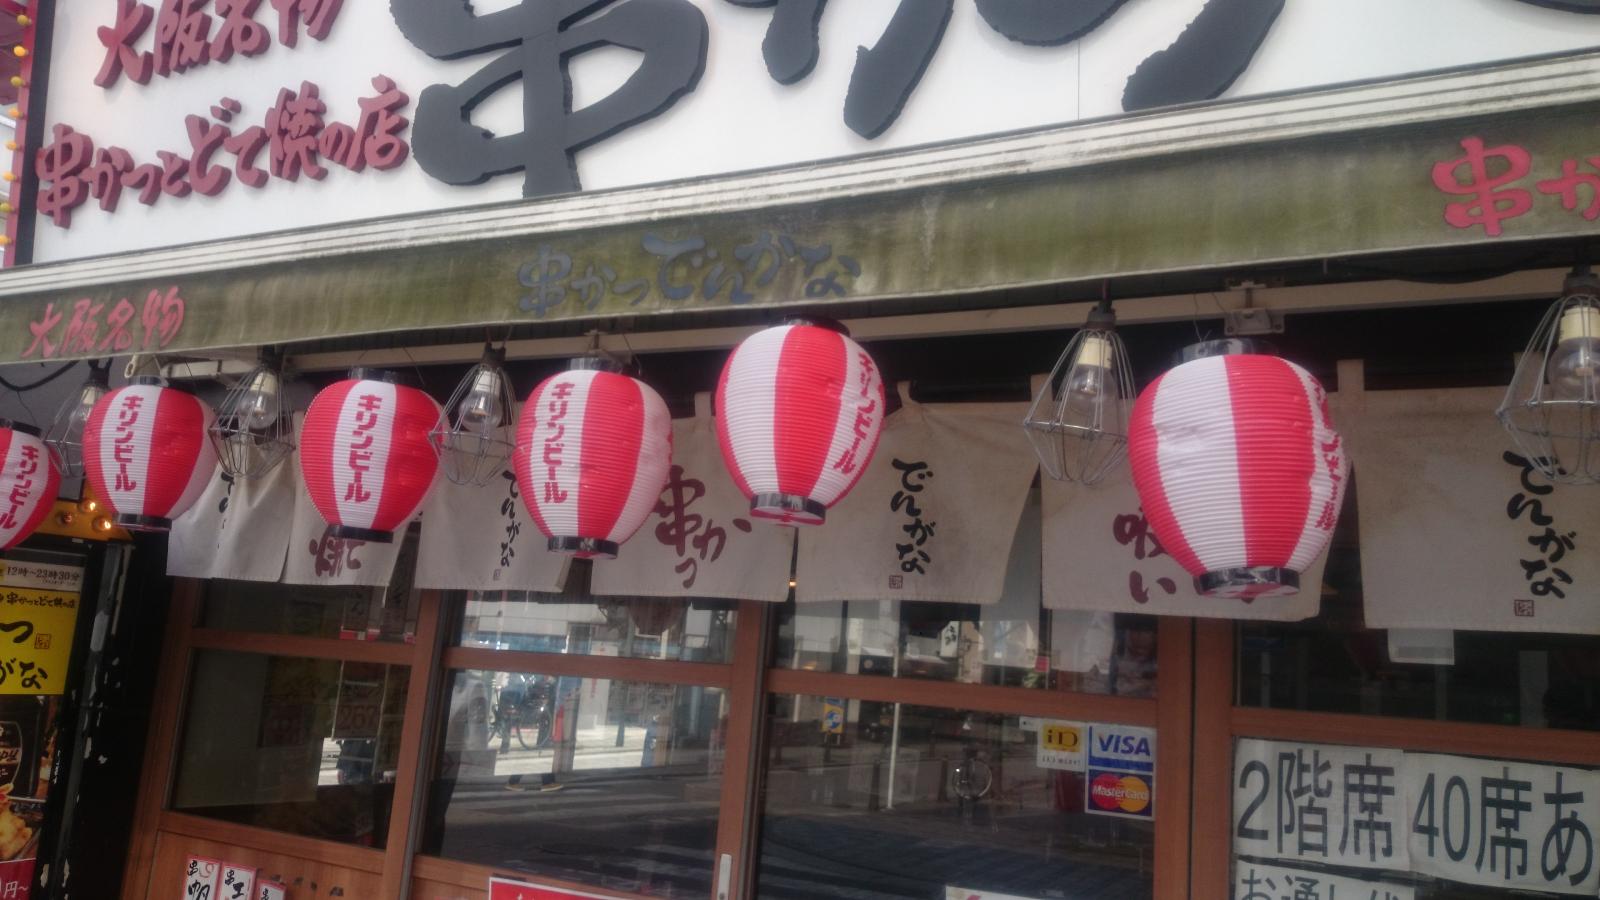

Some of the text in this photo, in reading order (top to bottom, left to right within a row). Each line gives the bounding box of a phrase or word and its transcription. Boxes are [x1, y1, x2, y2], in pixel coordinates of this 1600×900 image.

[21, 285, 185, 358] 大阪名物
[517, 231, 861, 317] 串かつでんがな
[114, 394, 144, 492] キリンビール
[344, 393, 382, 503] キリンビール
[543, 381, 575, 504] キリンビール
[834, 352, 874, 474] キリンビール
[0, 445, 39, 529] キリンビール
[652, 465, 752, 589] 串かつ
[891, 458, 936, 575] でんがな
[1502, 451, 1576, 599] でんがな
[1047, 729, 1078, 748] iD
[1098, 734, 1151, 757] VISA
[1091, 784, 1149, 800] MasterCard
